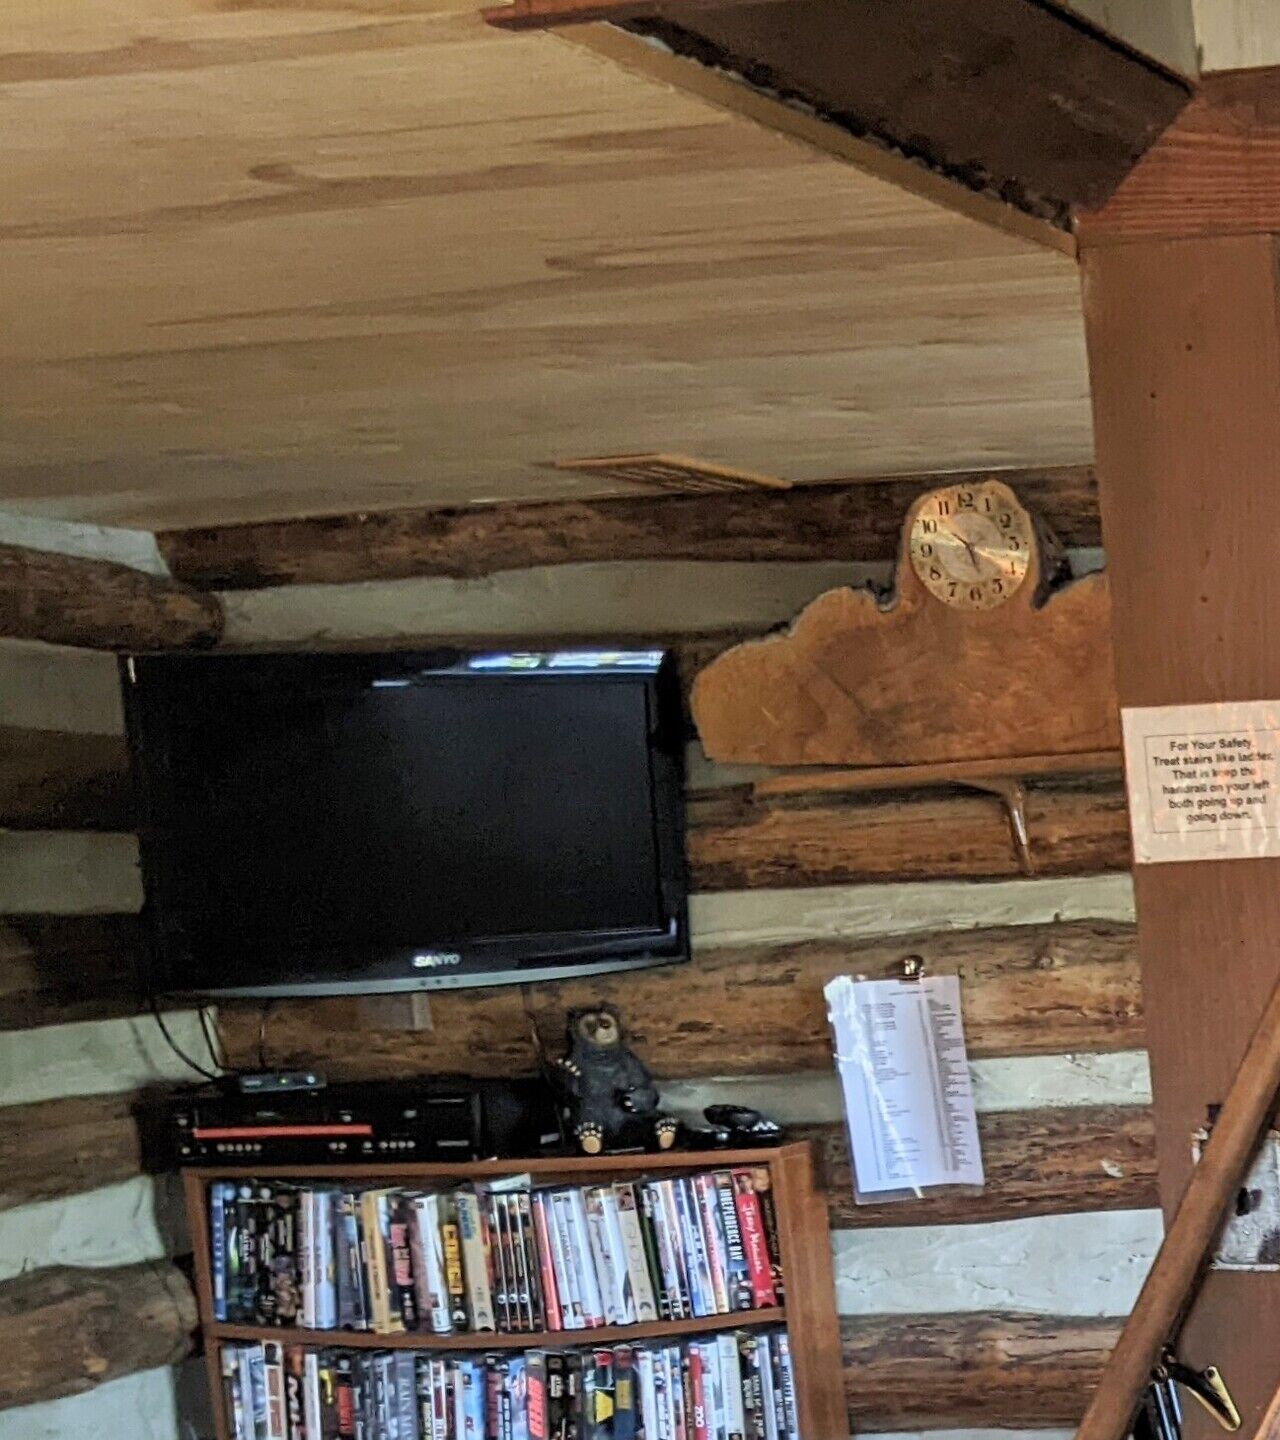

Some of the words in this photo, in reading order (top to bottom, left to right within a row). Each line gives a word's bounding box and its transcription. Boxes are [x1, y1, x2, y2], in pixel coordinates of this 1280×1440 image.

[957, 492, 973, 508] 12
[922, 519, 937, 534] 10
[1169, 741, 1188, 752] For
[1190, 740, 1216, 750] Your
[1153, 755, 1181, 767] Treat
[1183, 755, 1213, 766] stairs
[1215, 752, 1236, 763] like
[1172, 769, 1197, 780] That
[1168, 798, 1194, 809] both
[1197, 798, 1227, 811] going
[1186, 812, 1217, 825] going
[413, 953, 461, 968] SANYO
[720, 1188, 742, 1243] INDEPENDENCE
[729, 1245, 744, 1261] DAY
